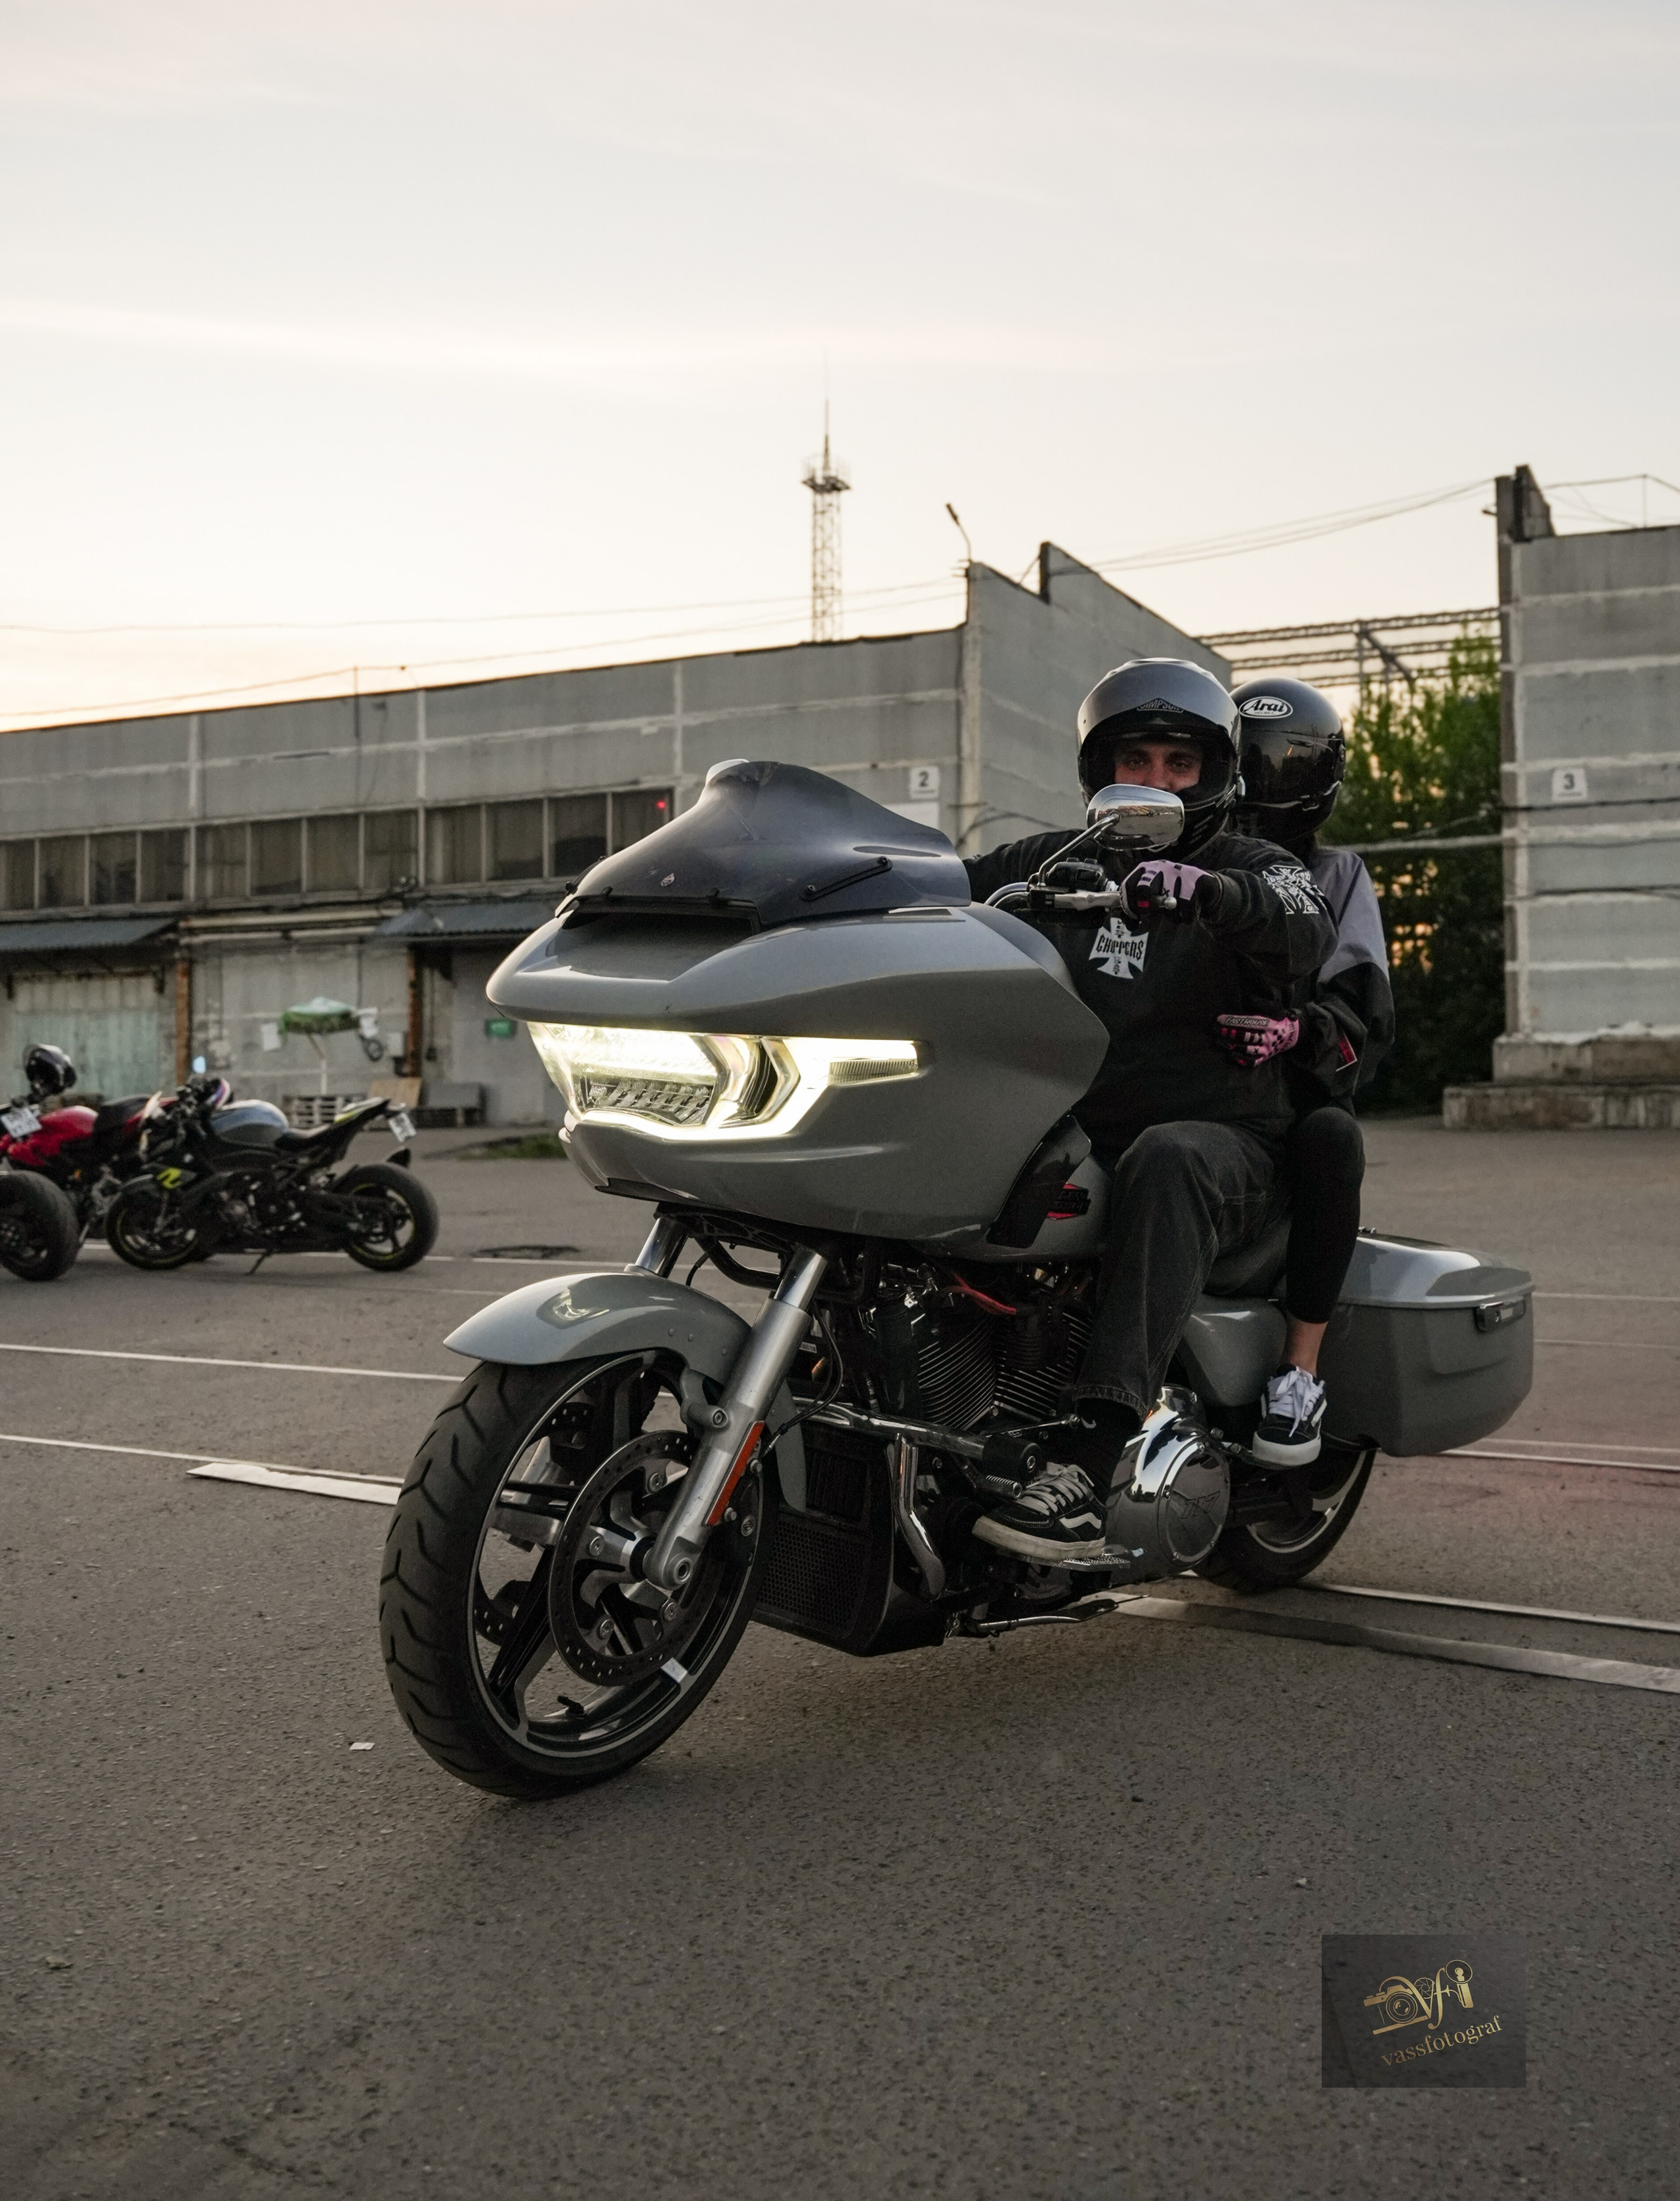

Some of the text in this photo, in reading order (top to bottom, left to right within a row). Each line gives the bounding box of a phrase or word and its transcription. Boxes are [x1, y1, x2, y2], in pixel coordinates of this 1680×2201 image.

[1243, 699, 1286, 713] Arai
[919, 770, 929, 787] 2
[1563, 774, 1574, 790] 3
